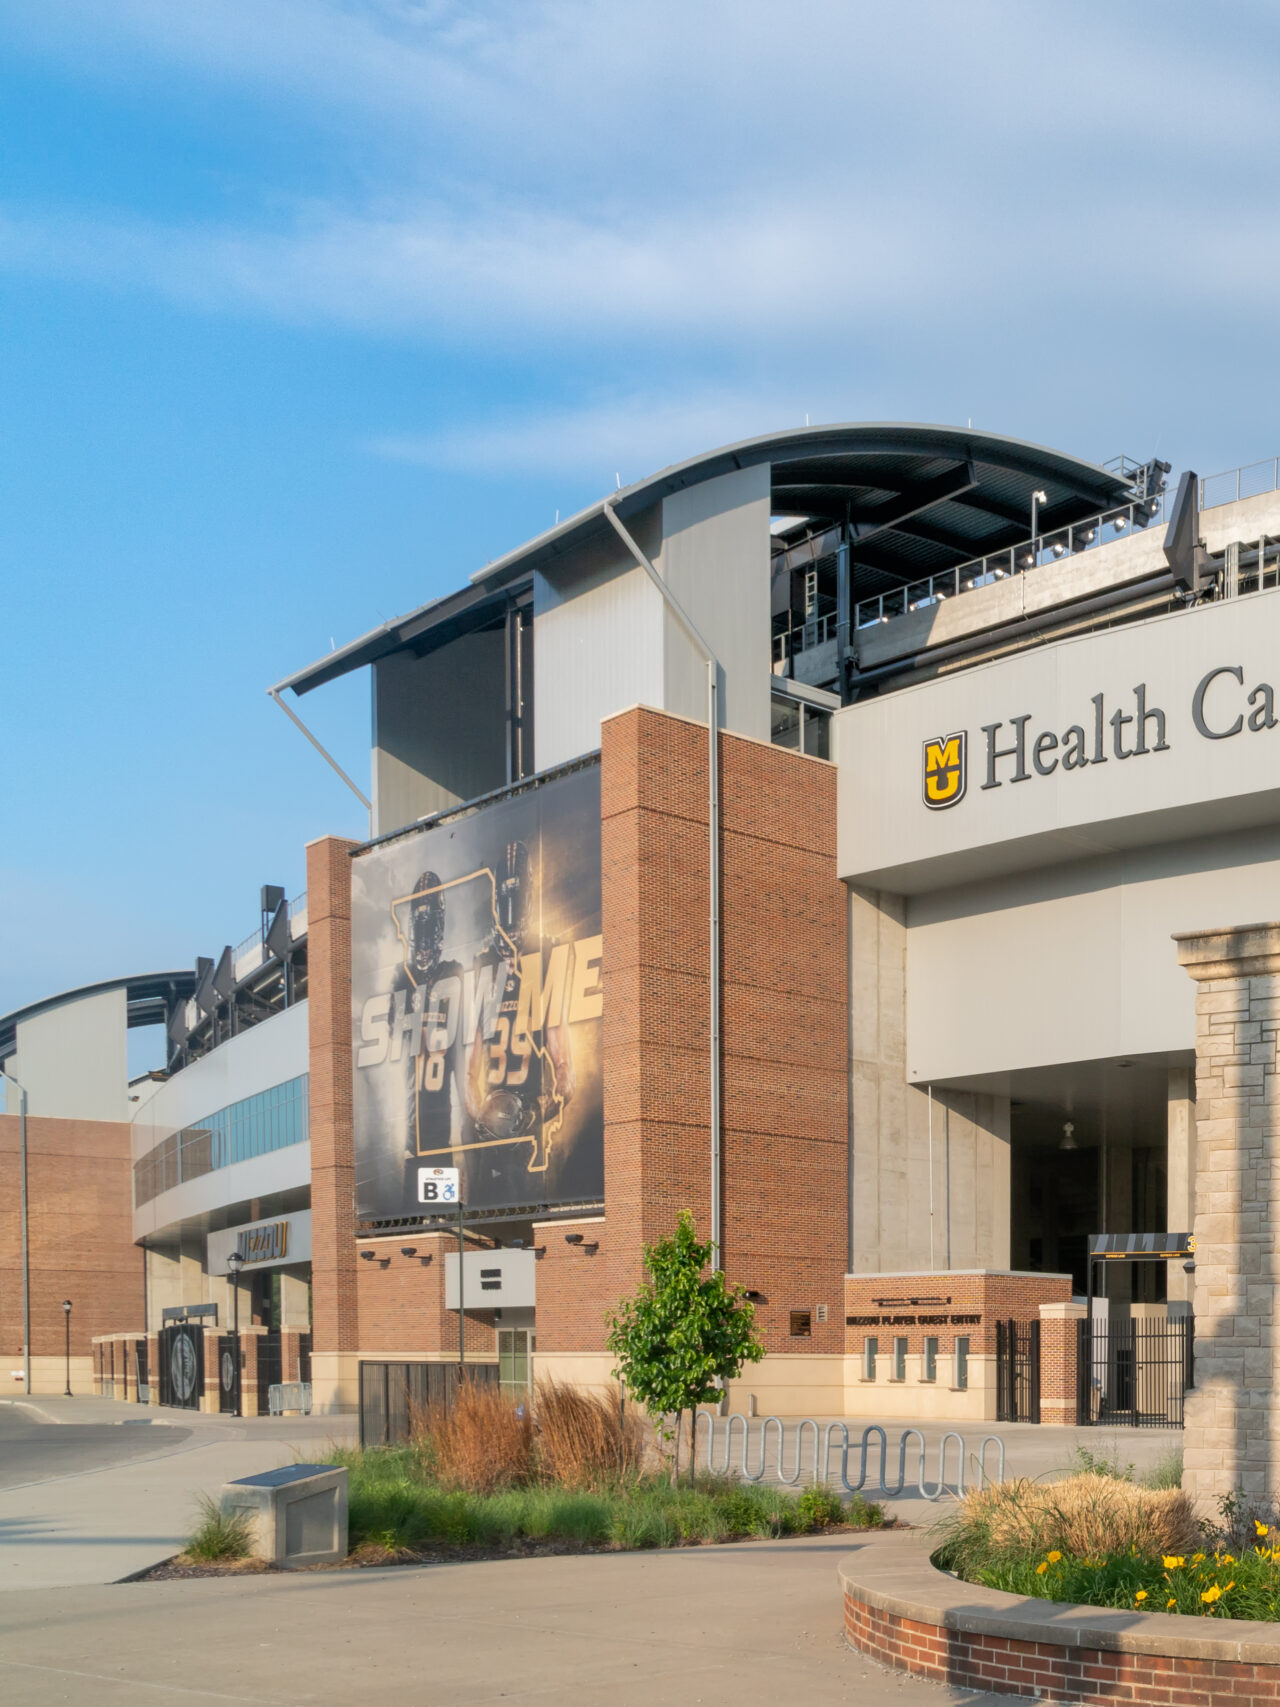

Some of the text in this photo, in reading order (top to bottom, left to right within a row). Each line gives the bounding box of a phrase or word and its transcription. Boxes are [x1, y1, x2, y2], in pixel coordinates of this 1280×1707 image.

[980, 682, 1170, 790] Health
[357, 934, 603, 1068] SHOW ME
[488, 1016, 533, 1085] 39
[424, 1182, 439, 1200] B
[237, 1221, 287, 1264] MIZZOU
[882, 1315, 916, 1325] PLAYER
[918, 1315, 949, 1325] GUEST
[950, 1314, 982, 1324] ENTRY
